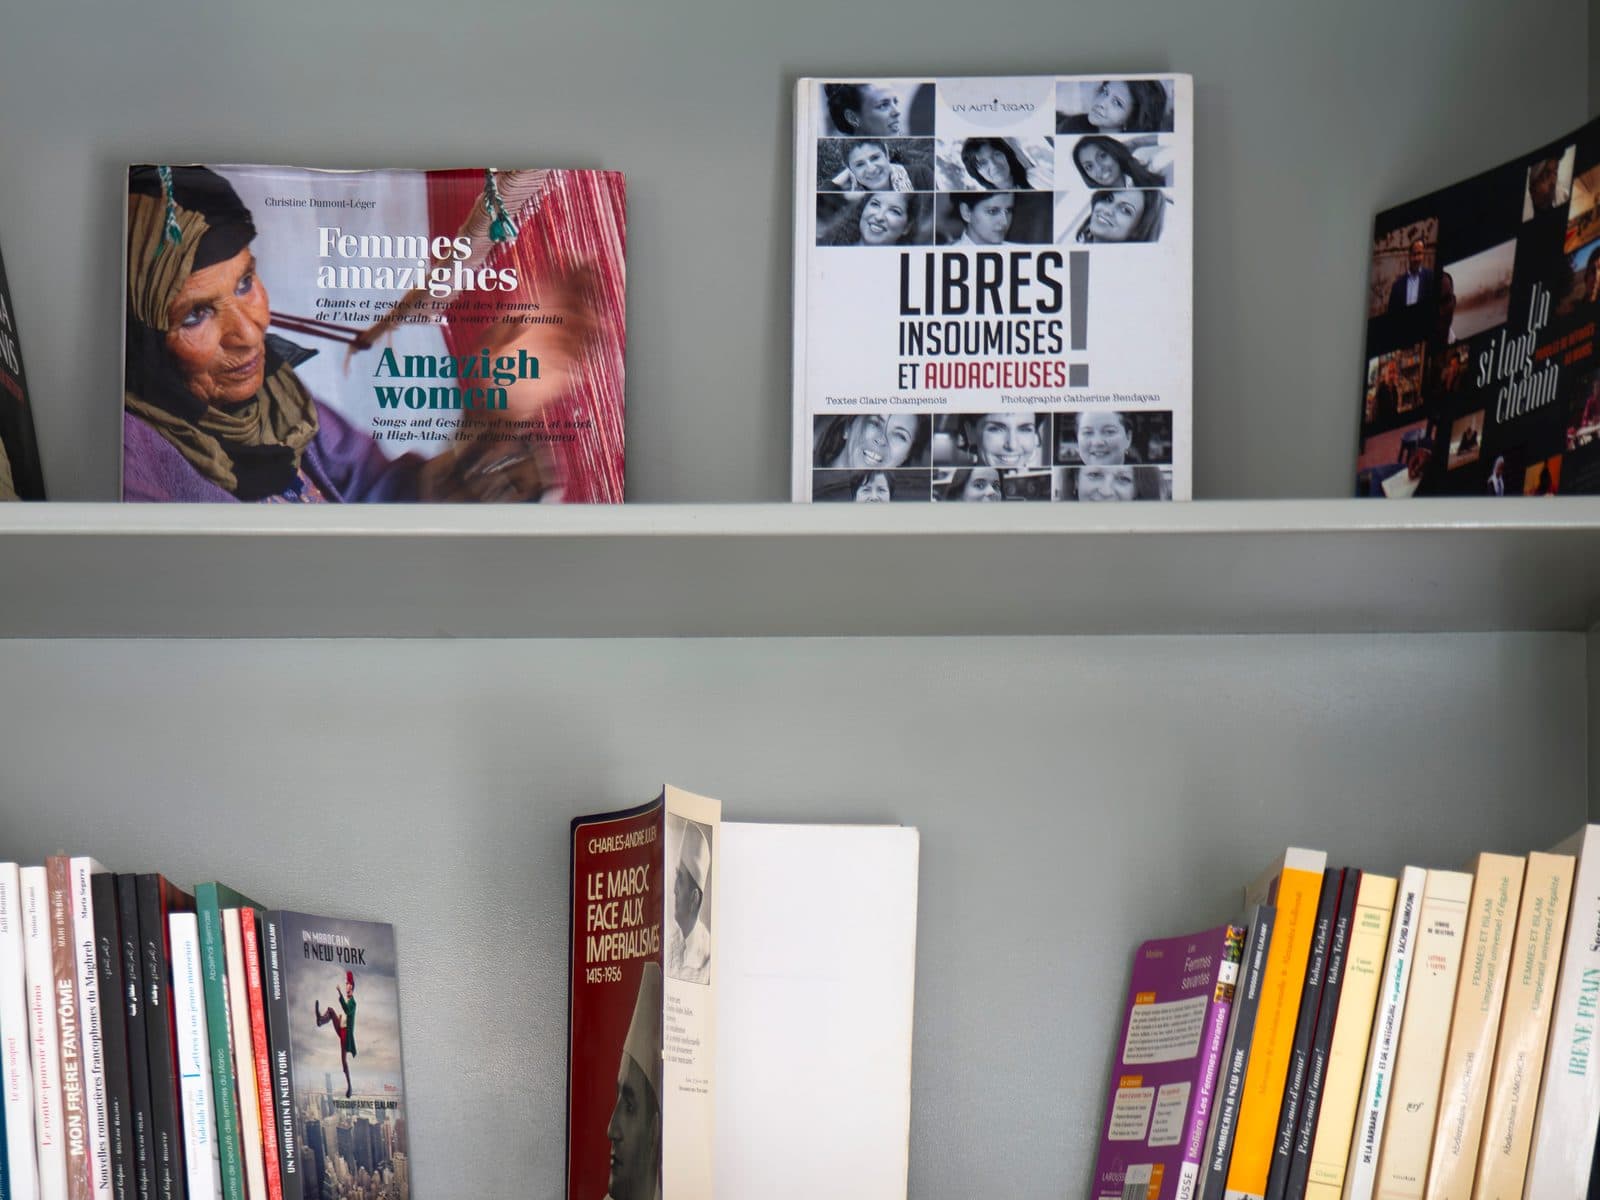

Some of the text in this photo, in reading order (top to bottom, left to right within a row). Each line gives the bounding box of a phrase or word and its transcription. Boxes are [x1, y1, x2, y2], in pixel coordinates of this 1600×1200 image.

[265, 197, 376, 210] Christine Dumont-Léger
[317, 226, 473, 260] Femmes
[317, 260, 519, 299] amazighes
[899, 250, 1064, 316] LIBRES
[898, 319, 1063, 357] INSOUMISES
[373, 347, 541, 387] Amazigh
[897, 360, 1067, 390] ET AUDACIEUSES
[1475, 327, 1537, 390] si long
[374, 386, 509, 411] women
[825, 395, 948, 407] Textes Claire Champenois
[1000, 392, 1161, 406] Photographe Catherine Bendayan
[1495, 359, 1560, 425] chemin
[372, 430, 383, 440] in
[454, 430, 473, 442] the
[520, 430, 534, 443] of
[536, 433, 576, 442] women
[78, 868, 88, 919] Marta Segarra
[587, 863, 650, 901] LE MAROC
[587, 897, 644, 932] FACE AUX
[302, 930, 351, 946] UN MAROCAIN
[311, 945, 366, 966] NEW YORK
[586, 923, 660, 963] IMPERIALISMES
[1309, 918, 1329, 986] Bahaa Trabelsi
[1471, 898, 1493, 987] FEMMES ET ISLAM
[268, 923, 281, 1000] YOUSSOUF AMINE ELALAMY
[585, 966, 622, 985] 1415-1956
[1576, 968, 1600, 1019] FRAIN
[58, 978, 85, 1156] MON FRÈRE FANTÔME
[82, 941, 110, 1190] Nouvelles romancières francophones du Maghreb
[216, 1048, 226, 1073] Maroc
[218, 1075, 228, 1085] du
[1187, 1007, 1226, 1159] Molière Les Femmes savantes
[220, 1087, 231, 1118] femmes
[1278, 1056, 1305, 1156] Parlez-moi d'amour
[223, 1119, 233, 1133] des
[225, 1135, 236, 1163] beauté
[228, 1165, 237, 1176] de
